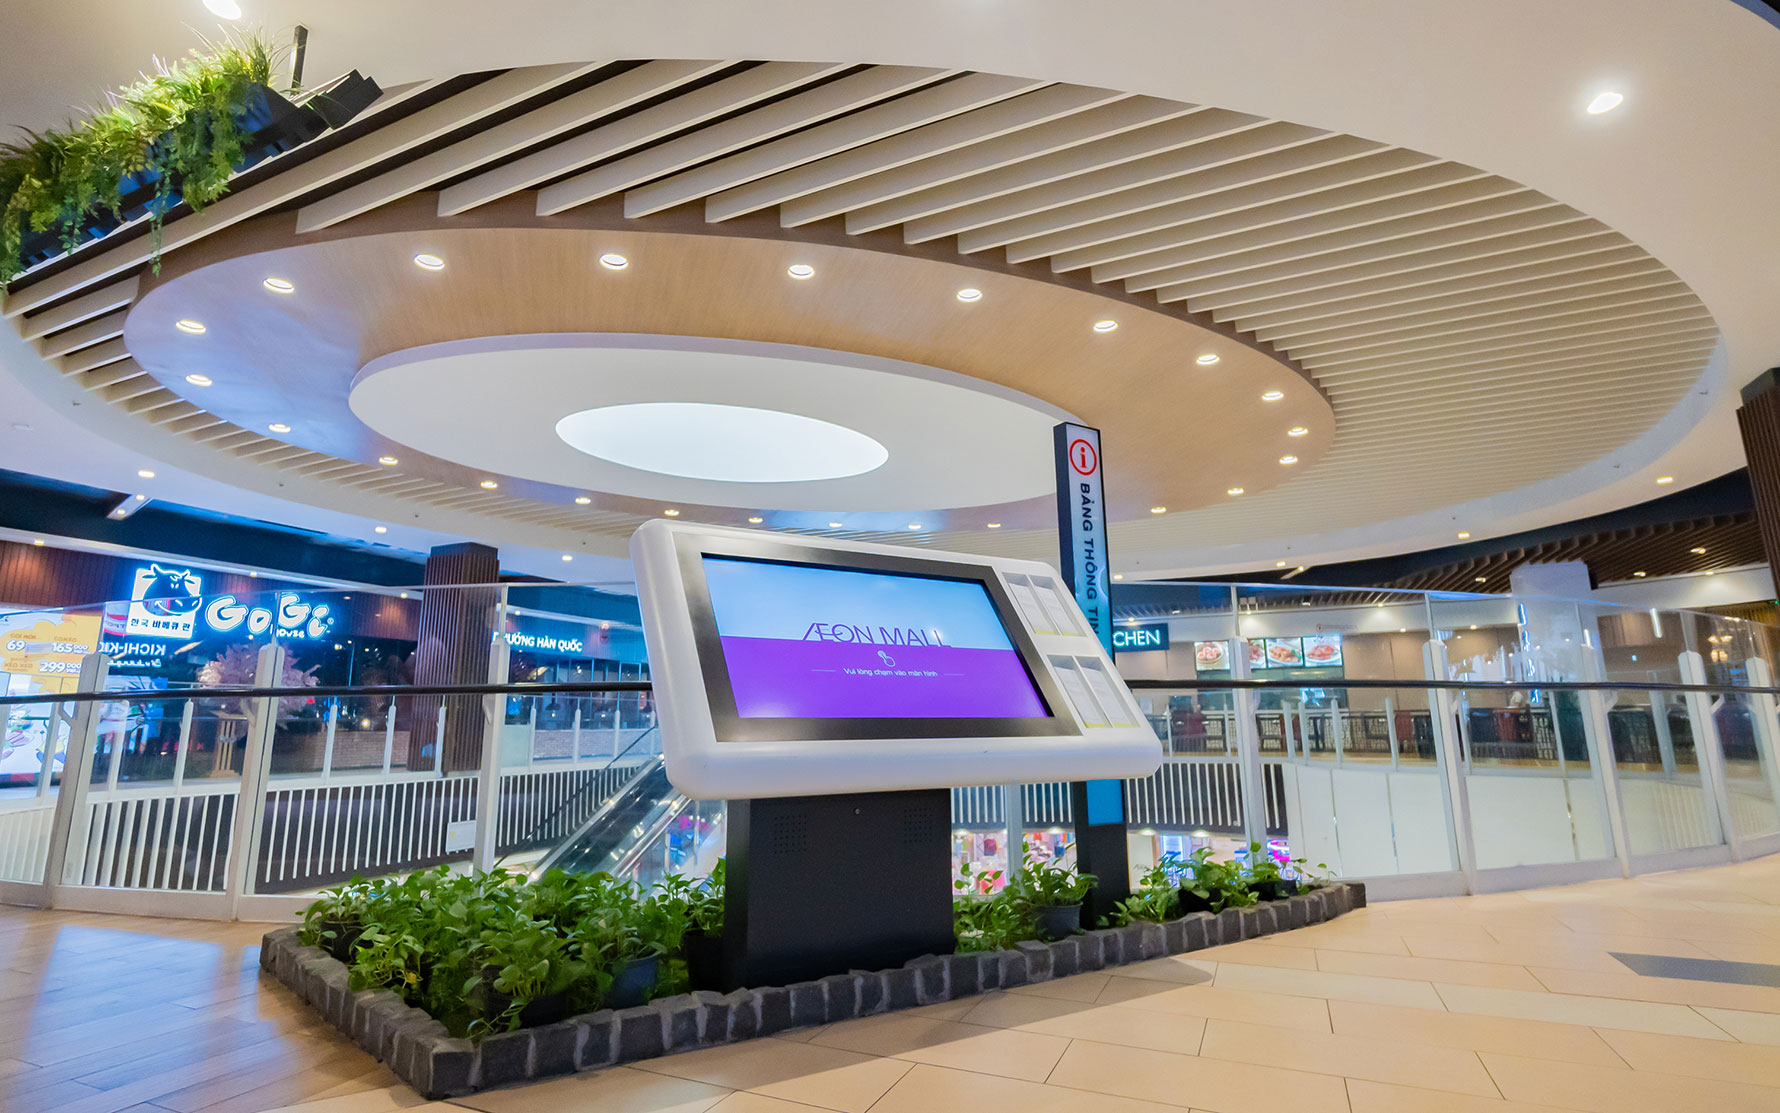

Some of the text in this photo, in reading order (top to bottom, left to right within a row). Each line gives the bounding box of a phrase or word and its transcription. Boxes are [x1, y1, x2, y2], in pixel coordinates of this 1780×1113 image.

[1080, 483, 1095, 532] BẢNG
[1084, 538, 1098, 599] THÔNG
[537, 635, 556, 649] HÀN
[558, 639, 583, 652] QUỐC
